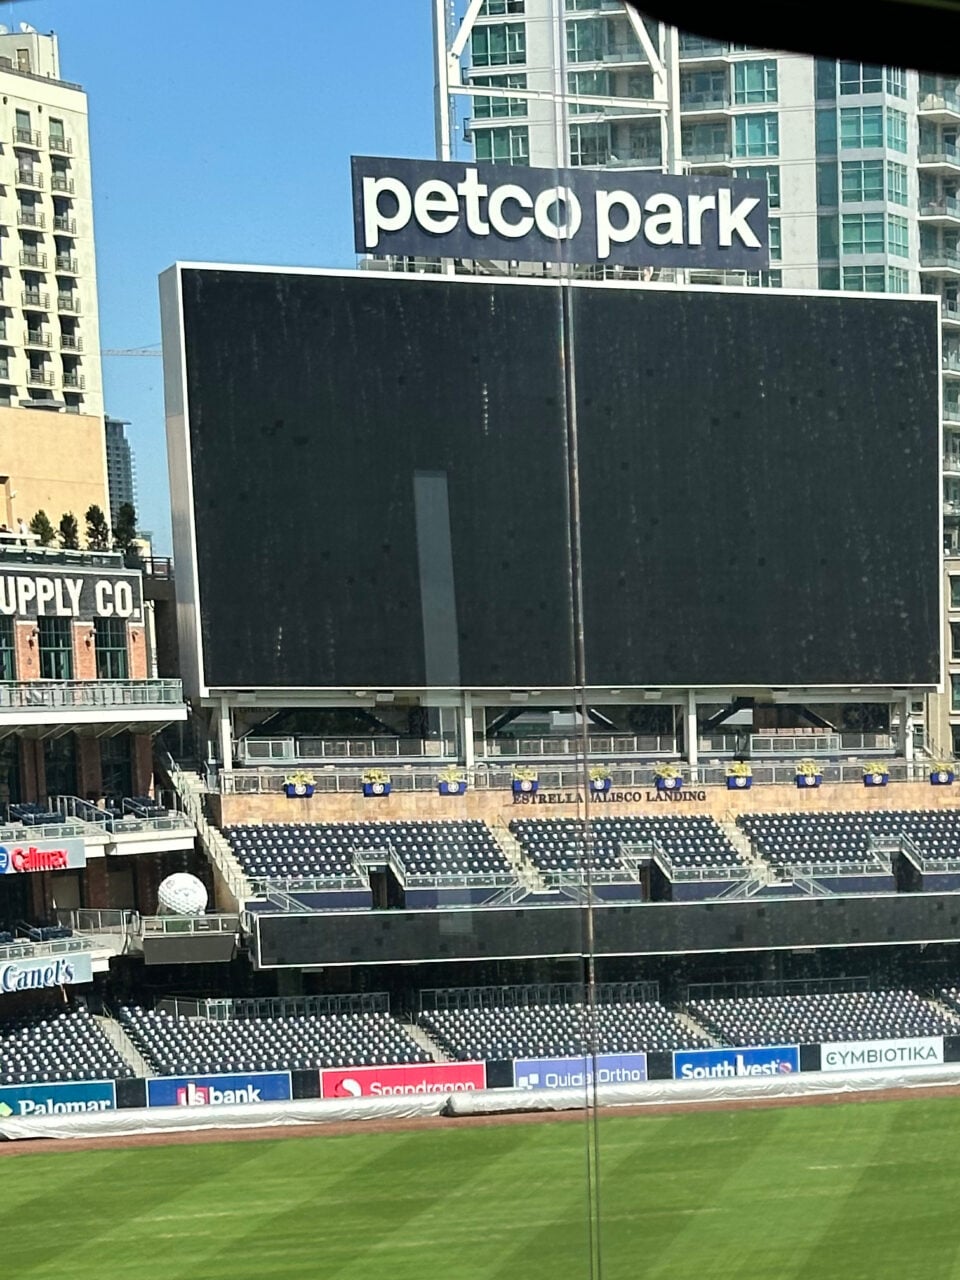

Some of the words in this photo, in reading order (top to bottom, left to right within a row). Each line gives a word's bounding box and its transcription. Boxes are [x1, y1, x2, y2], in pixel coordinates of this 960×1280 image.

[362, 168, 582, 250] petco
[596, 188, 762, 259] park
[95, 580, 140, 617] CO.
[512, 793, 584, 804] ESTRELLA
[590, 792, 642, 803] JALISCO
[646, 790, 706, 802] LANDING
[11, 847, 69, 872] Calimax
[2, 958, 74, 991] Canel's
[18, 1098, 111, 1116] Palomar
[209, 1084, 262, 1105] bank
